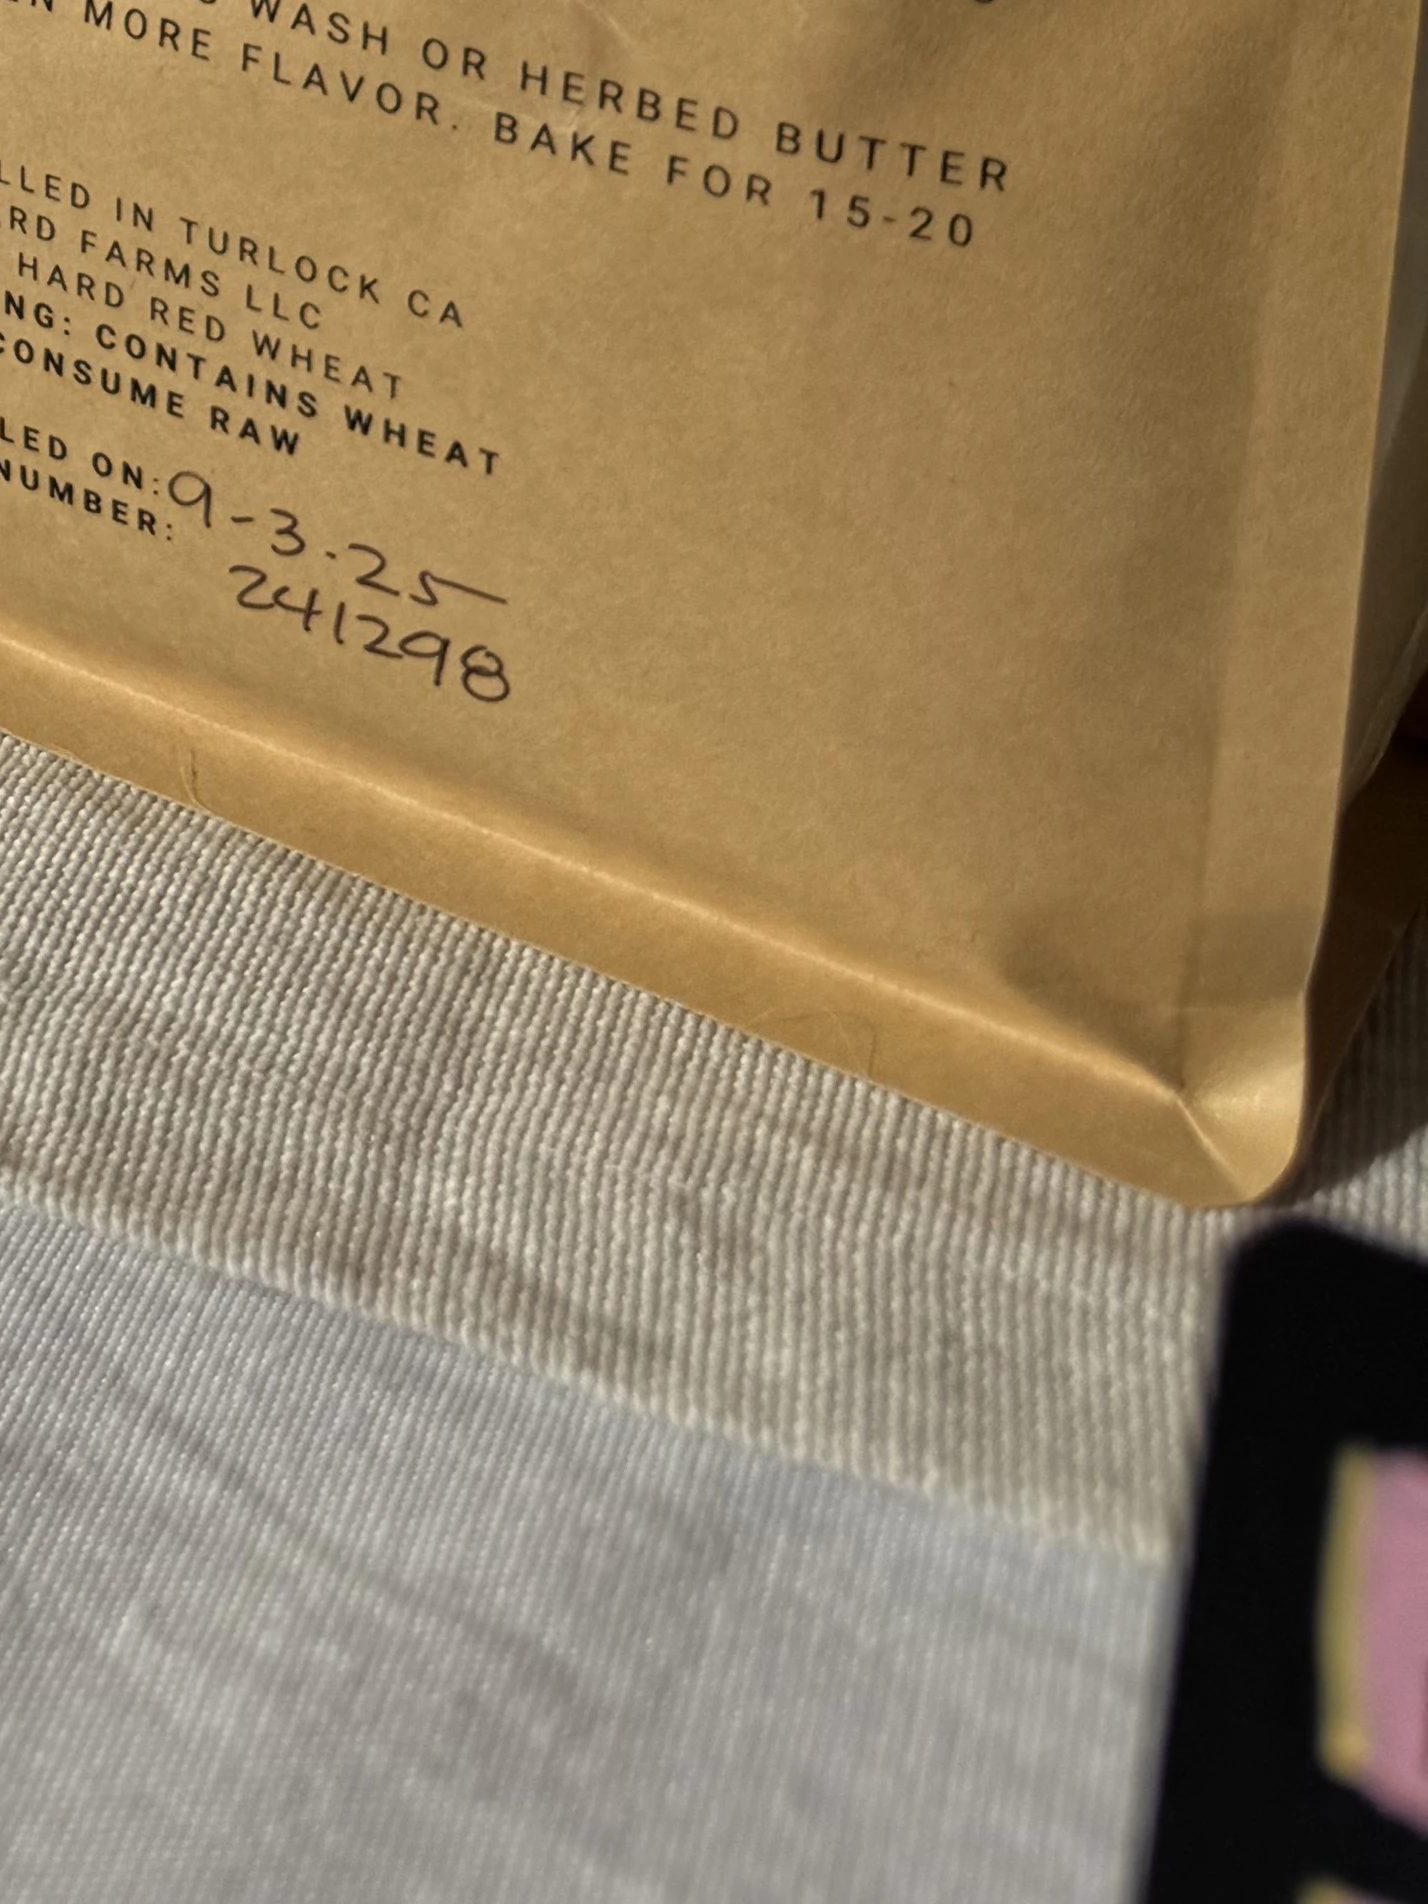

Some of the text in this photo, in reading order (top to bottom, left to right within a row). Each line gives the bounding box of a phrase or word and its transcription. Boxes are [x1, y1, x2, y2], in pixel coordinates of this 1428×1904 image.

[421, 37, 487, 82] OR
[520, 60, 740, 141] HERBED
[775, 121, 1008, 193] BUTTER
[18, 251, 125, 310] HARD
[150, 296, 227, 344] RED
[251, 329, 402, 401] WHEAT
[80, 229, 220, 299] FARMS
[245, 283, 321, 331] LLC
[116, 196, 154, 233] IN
[179, 216, 380, 305] TURLOCK
[407, 289, 463, 329] CA
[95, 323, 318, 420] CONTAINS
[343, 404, 500, 476] WHEAT
[210, 404, 300, 457] RAW
[91, 451, 159, 496] ON:
[229, 564, 511, 703] 241298
